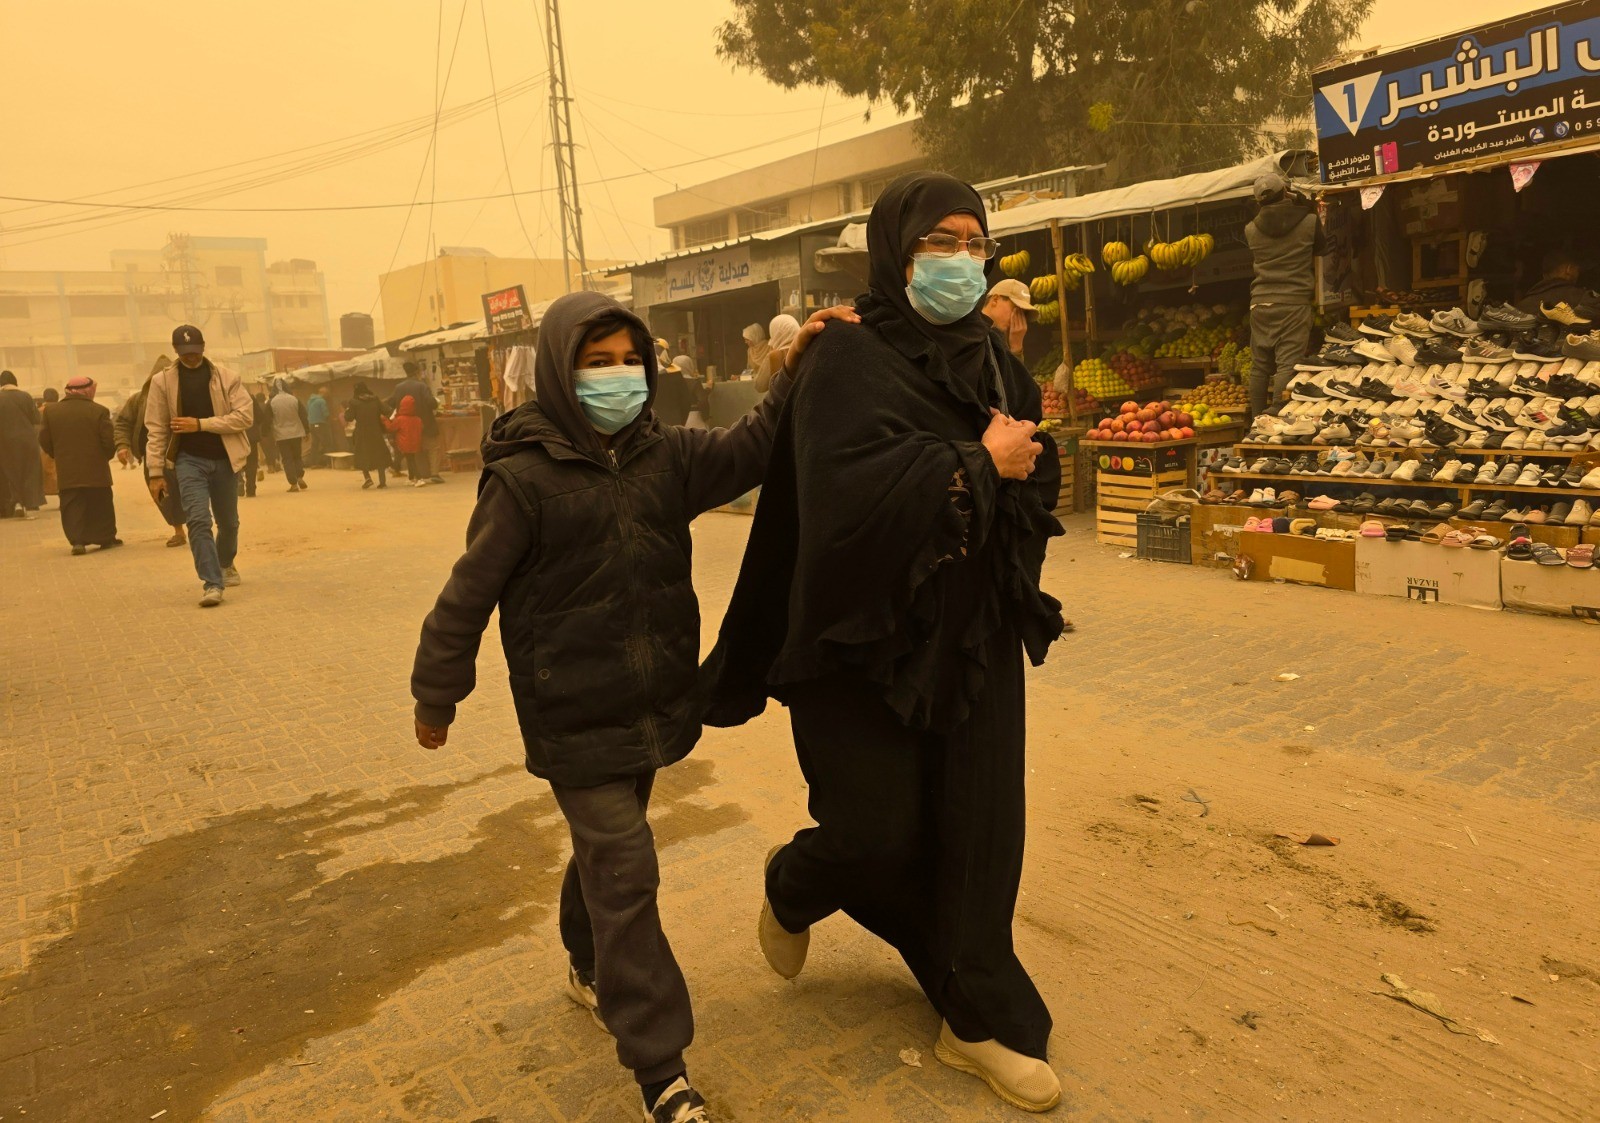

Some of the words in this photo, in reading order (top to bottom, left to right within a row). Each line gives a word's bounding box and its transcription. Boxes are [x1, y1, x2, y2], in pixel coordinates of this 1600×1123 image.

[1381, 27, 1559, 126] البشير
[1343, 82, 1358, 123] 1
[1328, 157, 1349, 170] الدفع
[1350, 153, 1371, 166] متوفر
[1328, 168, 1355, 182] التطبيق
[1355, 165, 1371, 175] عبر
[719, 262, 750, 285] صيدلية
[669, 271, 695, 298] بلسم
[1406, 576, 1439, 588] HAZAR
